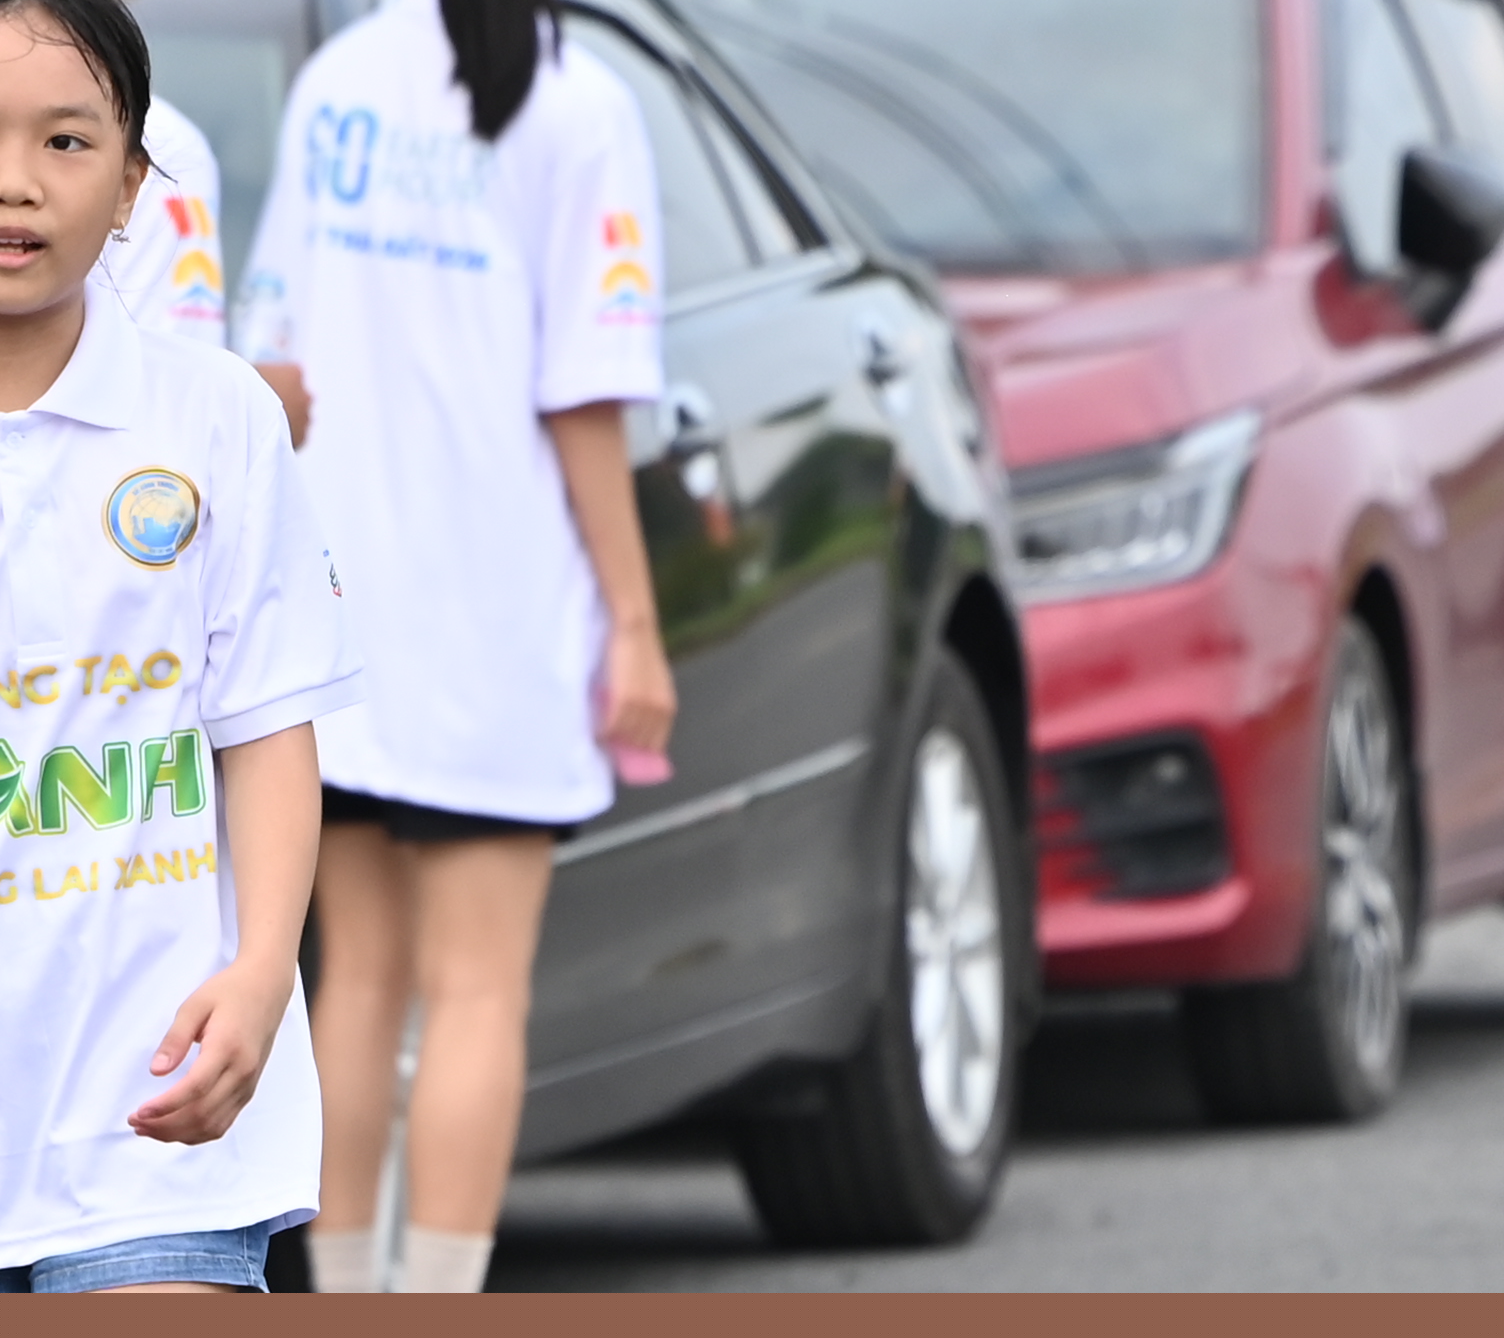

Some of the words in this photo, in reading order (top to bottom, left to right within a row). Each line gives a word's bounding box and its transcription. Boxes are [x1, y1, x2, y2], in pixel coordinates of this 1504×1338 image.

[74, 650, 182, 706] TẠO
[33, 861, 100, 901] LAI
[113, 841, 218, 890] XANH
